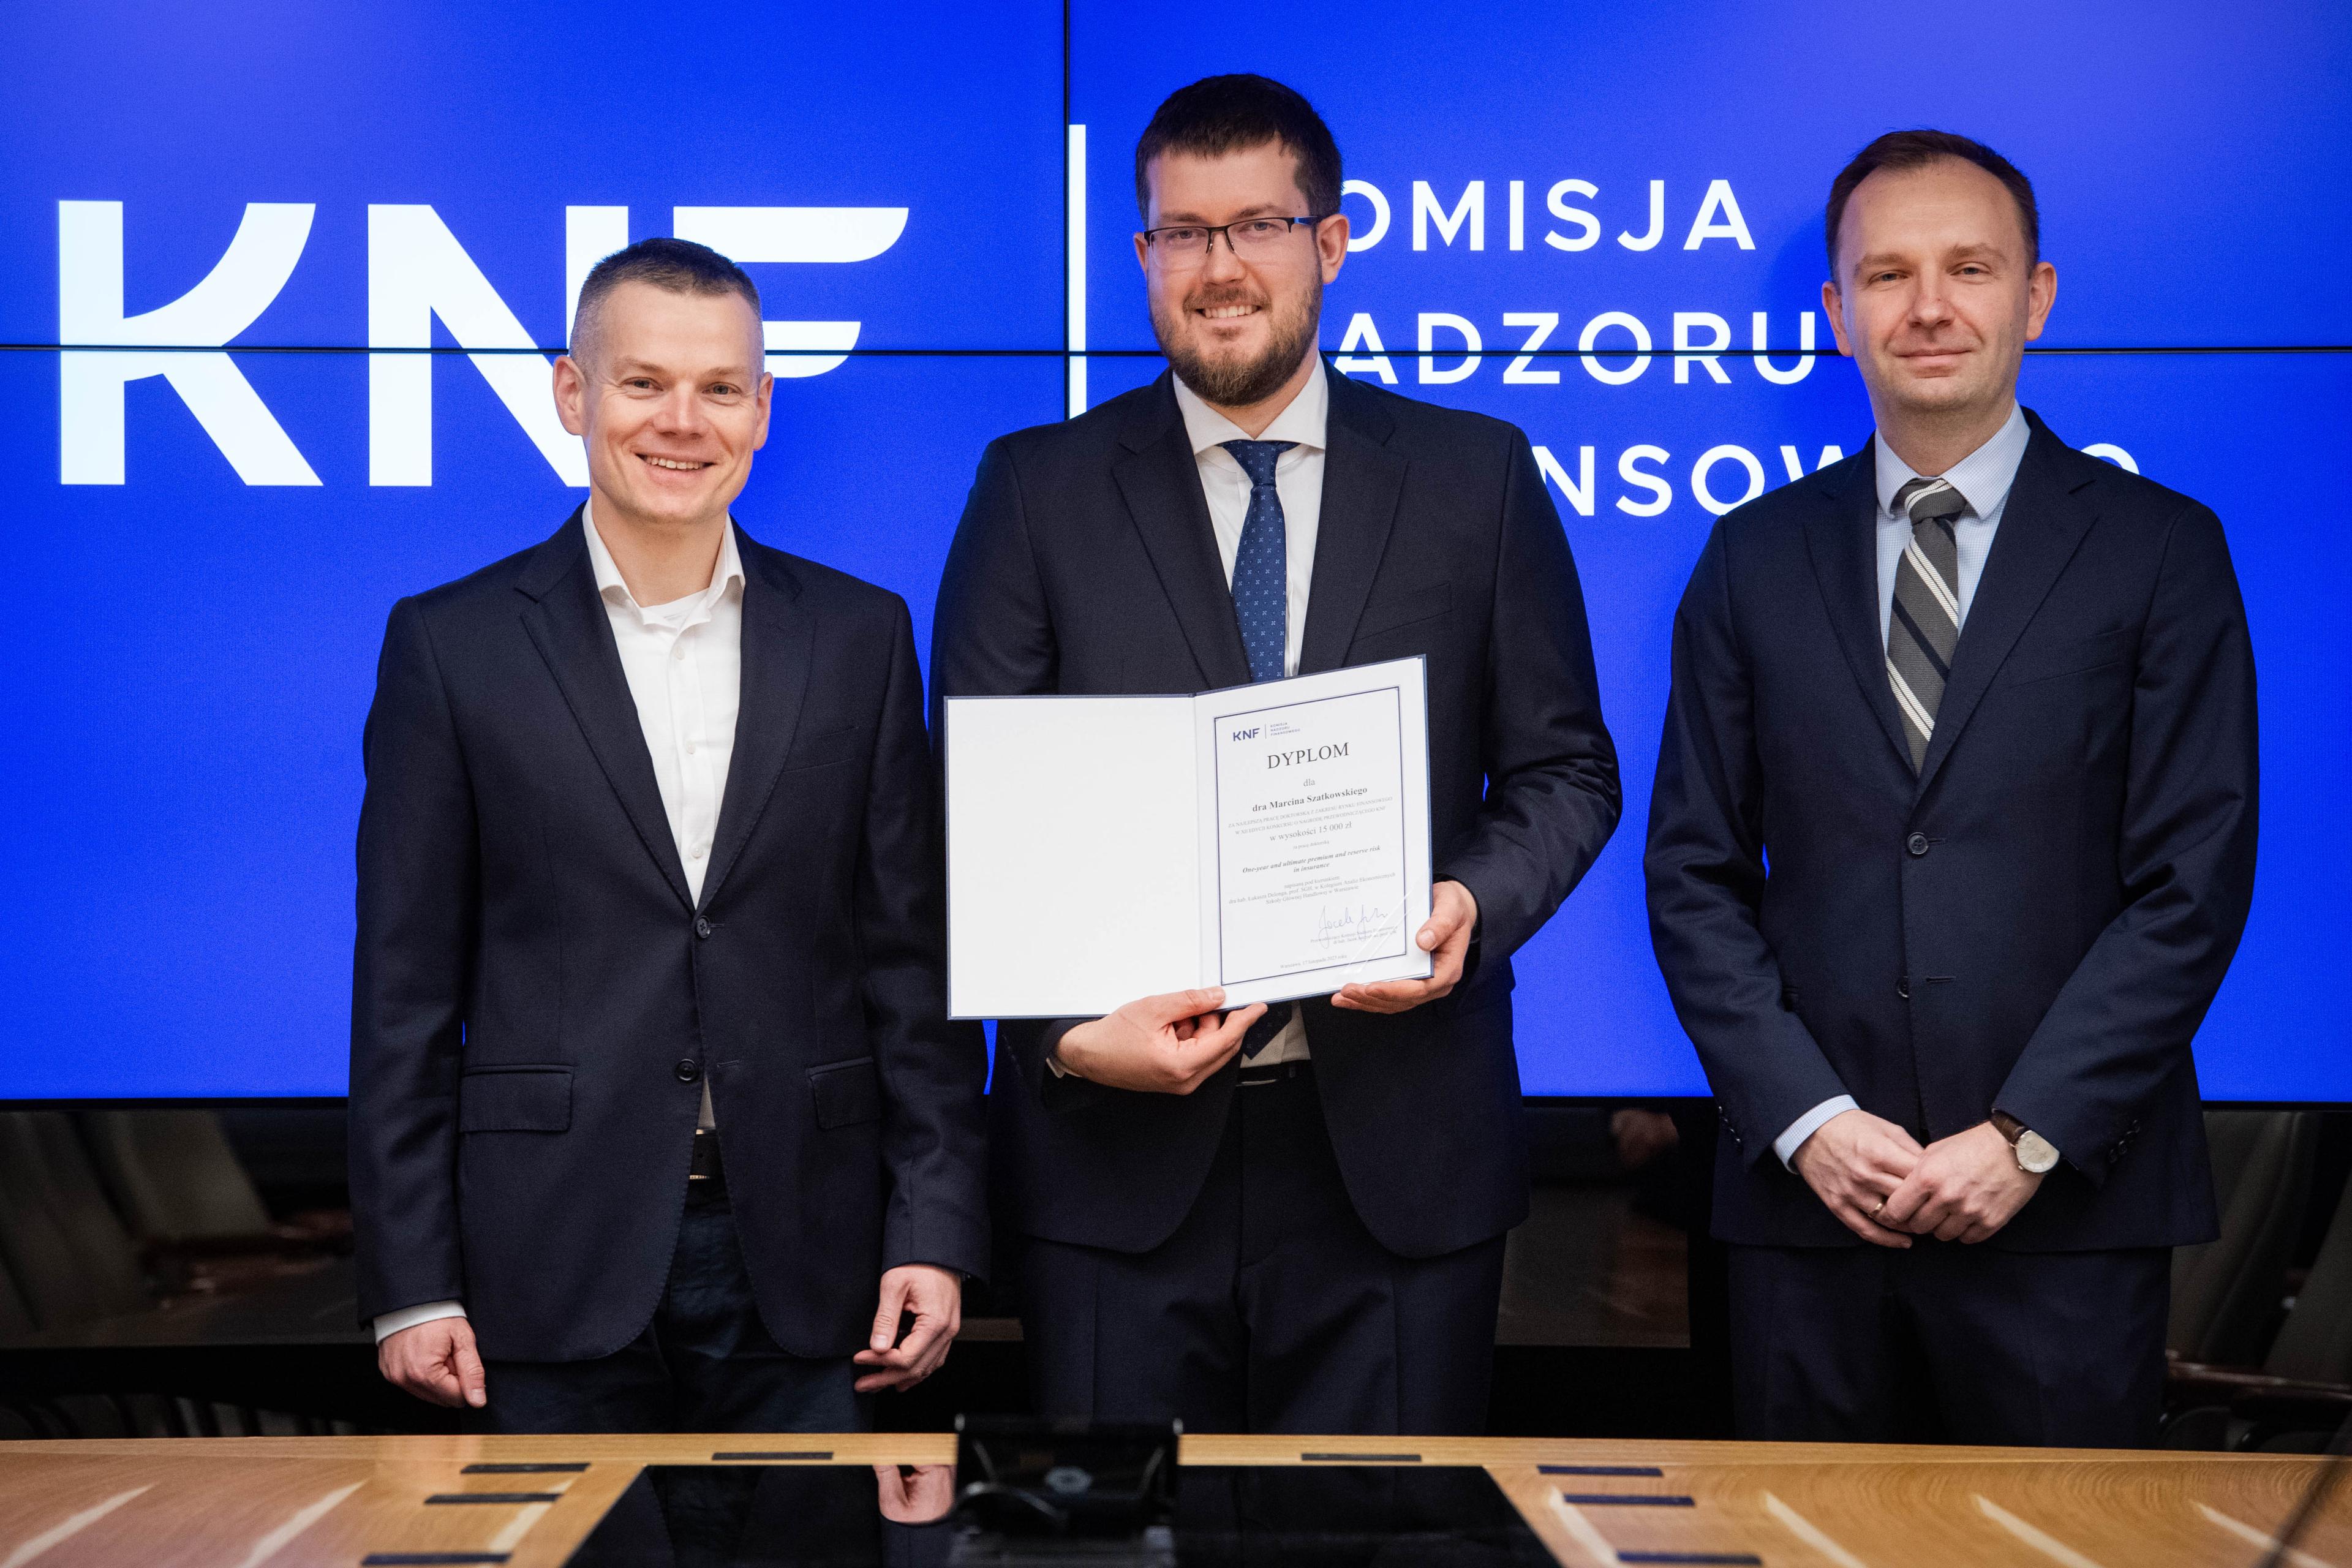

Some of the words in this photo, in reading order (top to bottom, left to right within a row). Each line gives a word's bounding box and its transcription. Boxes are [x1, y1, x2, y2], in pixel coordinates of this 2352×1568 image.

[1340, 178, 1756, 252] OMISJA
[1334, 311, 1817, 385] ADZORU
[1233, 728, 1261, 742] KNF
[1267, 742, 1349, 769] DYPLOM
[1303, 778, 1315, 787] dla
[1270, 798, 1305, 809] Marcina
[1306, 788, 1368, 802] Szatkowskiego
[1357, 796, 1393, 806] FINANSOWEGO
[1278, 828, 1316, 840] wysokości
[1329, 823, 1343, 831] 000
[1242, 864, 1269, 873] One-year
[1283, 858, 1306, 867] ultimate
[1307, 854, 1333, 864] premium
[1301, 862, 1330, 872] insurance
